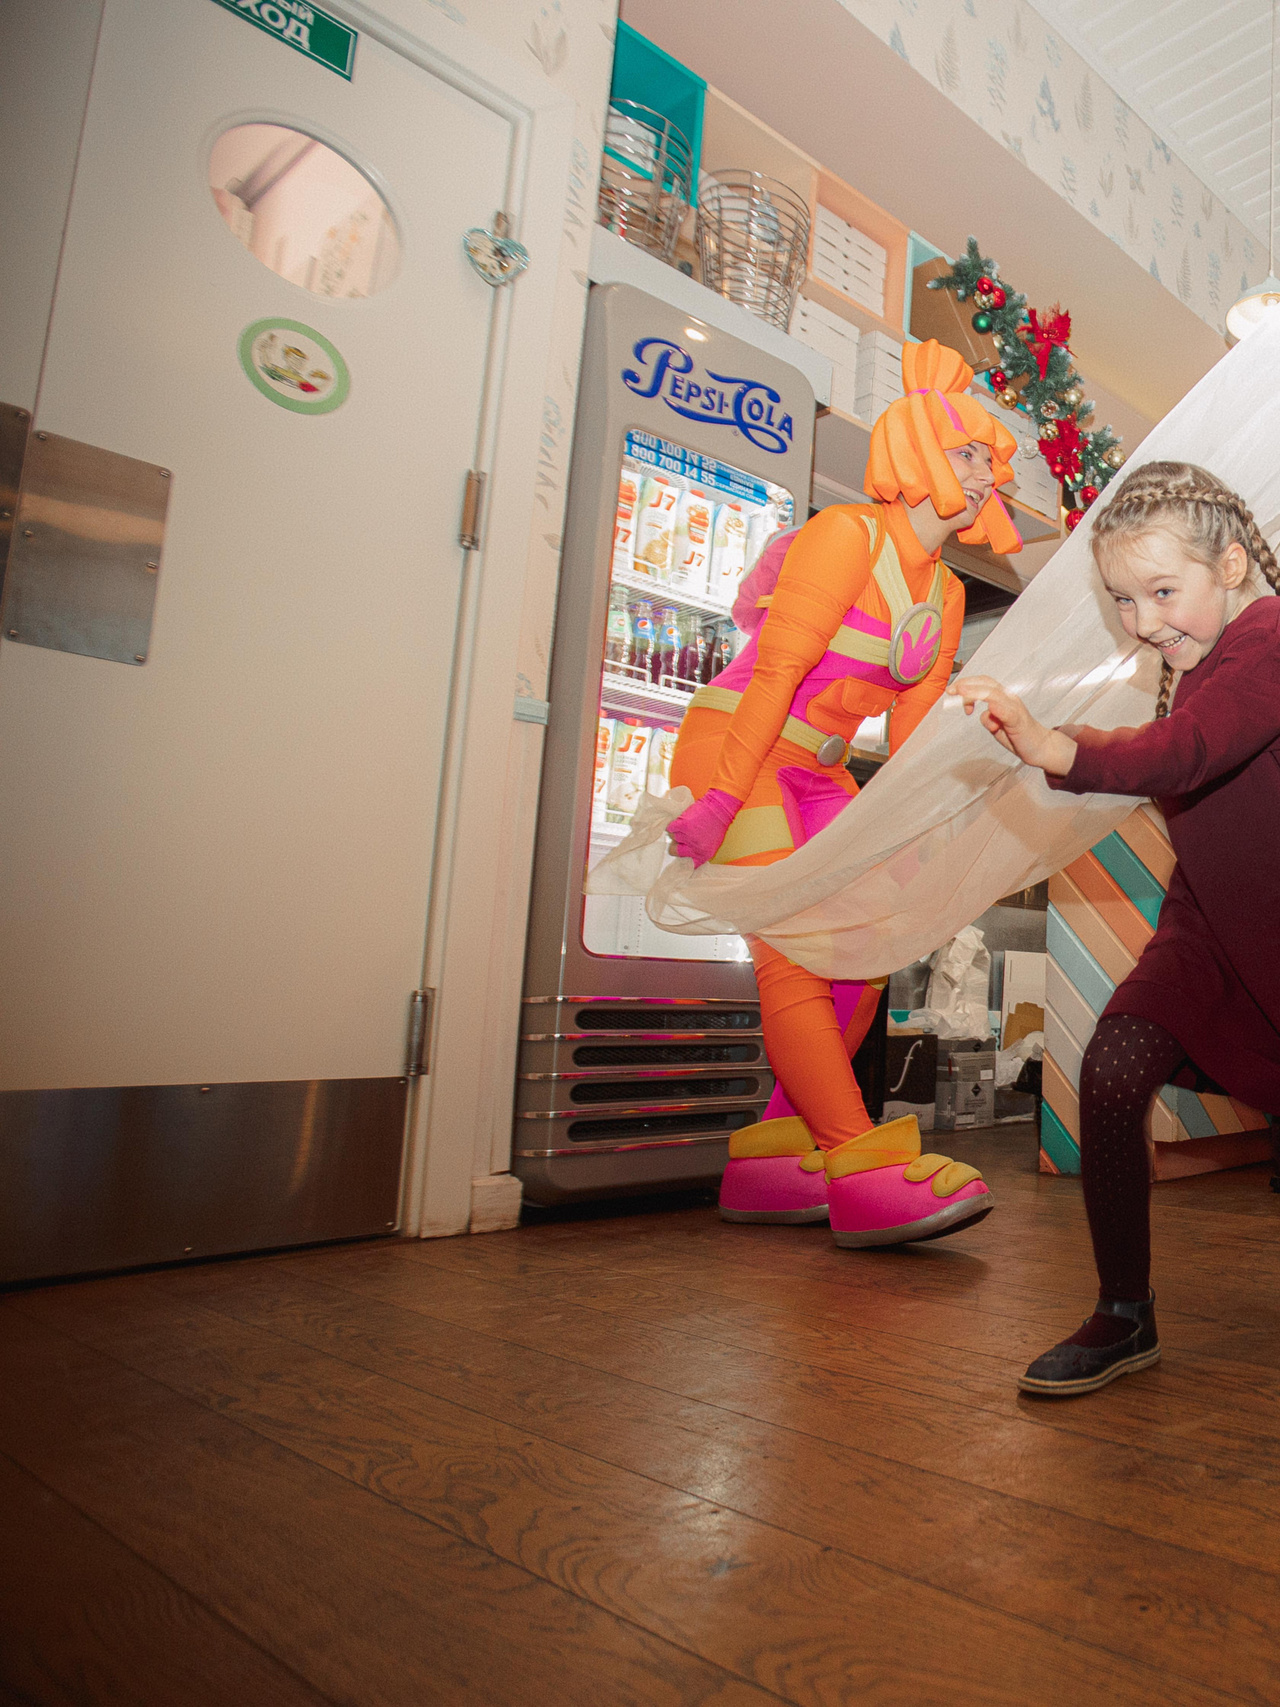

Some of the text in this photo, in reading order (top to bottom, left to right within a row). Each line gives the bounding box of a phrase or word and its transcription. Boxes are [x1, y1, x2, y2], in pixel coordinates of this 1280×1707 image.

[226, 0, 311, 51] ХОД
[631, 444, 655, 462] 800
[659, 454, 681, 472] 700
[684, 464, 699, 479] 14
[700, 470, 716, 486] 55
[649, 490, 676, 511] J7
[683, 551, 705, 567] J7
[617, 734, 647, 753] J7
